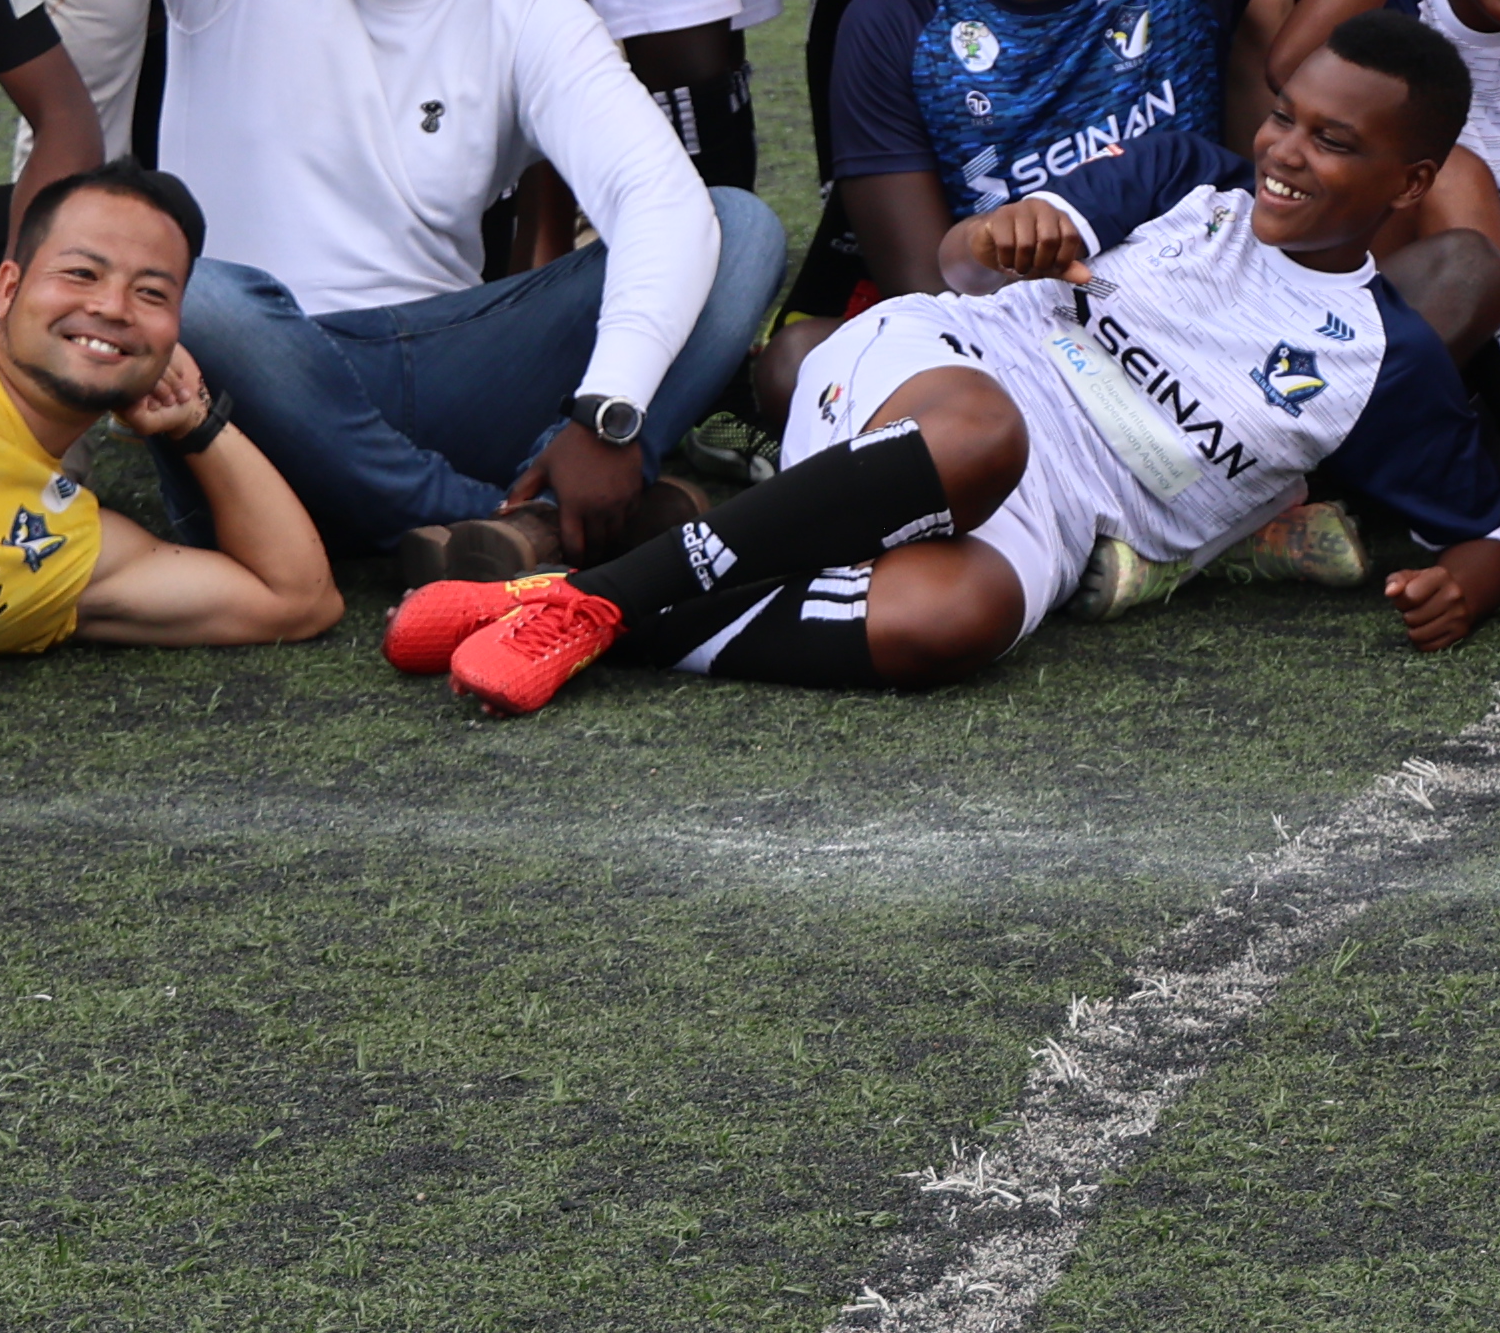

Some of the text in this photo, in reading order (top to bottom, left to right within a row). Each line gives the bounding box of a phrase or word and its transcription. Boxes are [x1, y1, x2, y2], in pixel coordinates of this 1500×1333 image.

[1010, 78, 1177, 195] SEINAN
[1052, 336, 1089, 375] JICA
[1093, 315, 1259, 481] SEINAN
[1090, 381, 1174, 493] Cooperation Agency
[1128, 409, 1184, 482] International
[681, 521, 715, 592] adidas
